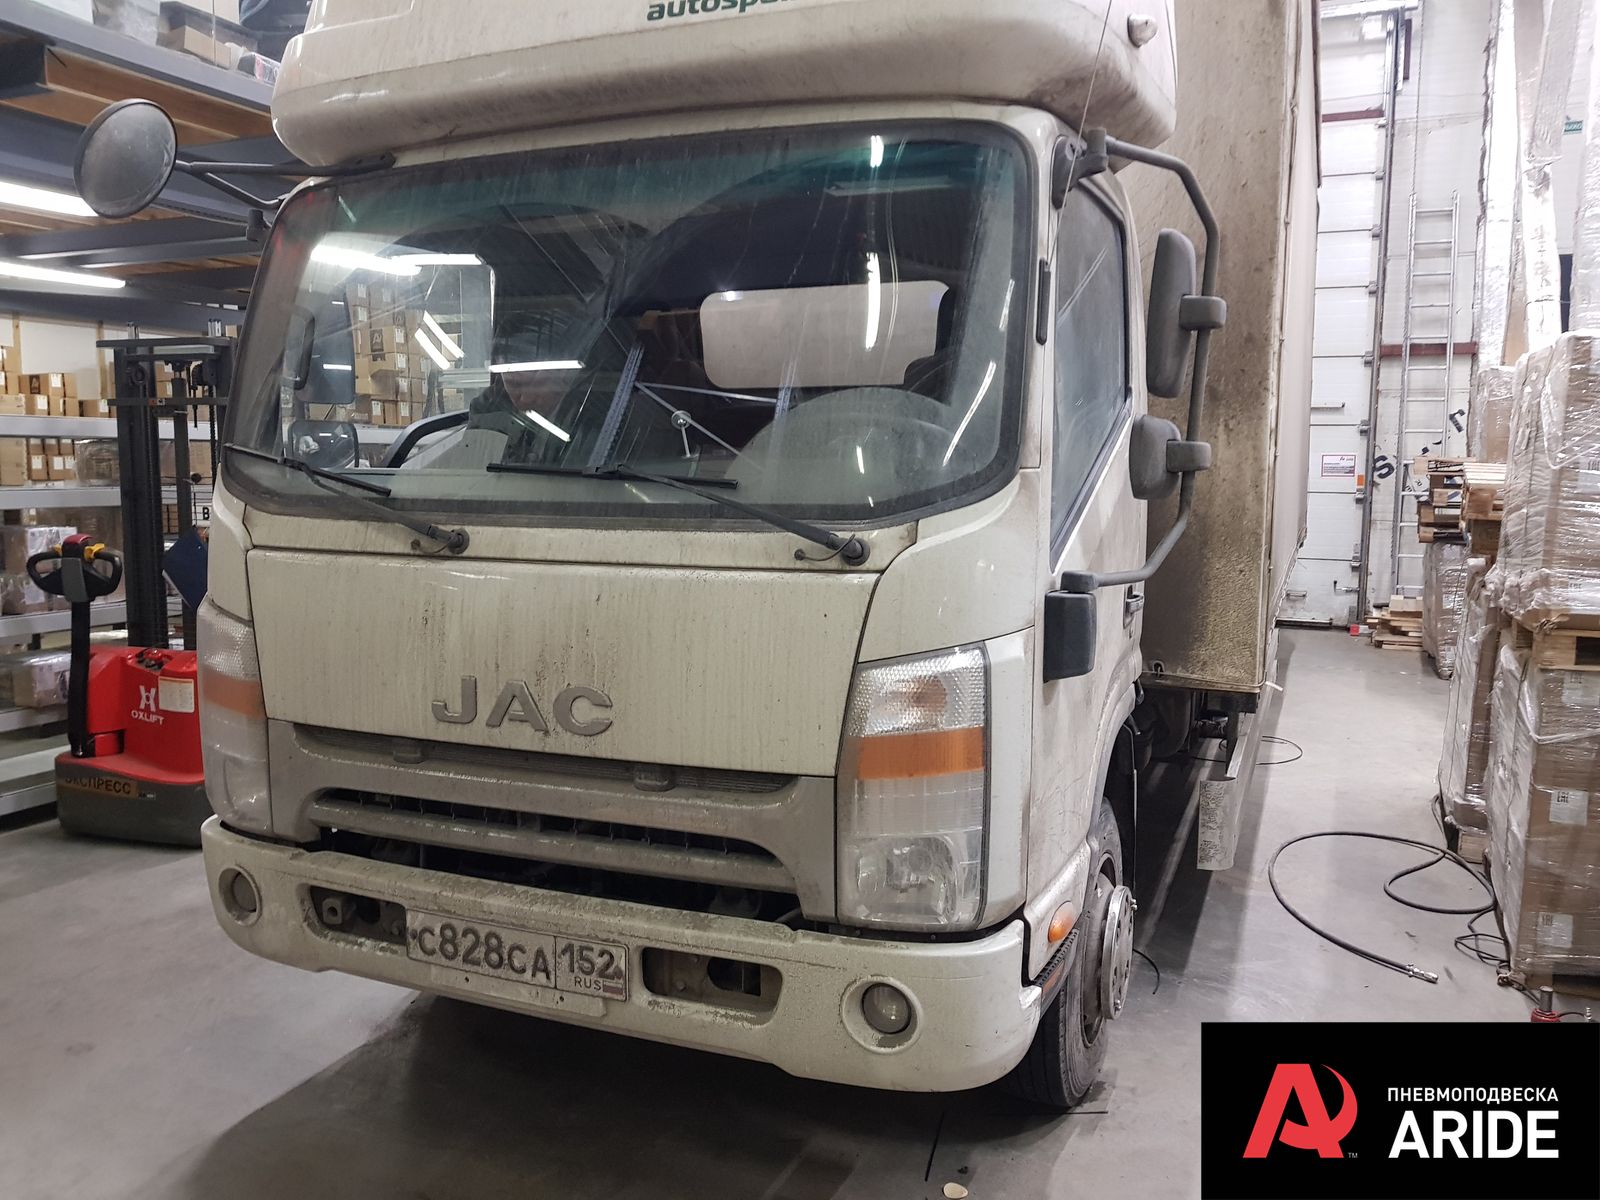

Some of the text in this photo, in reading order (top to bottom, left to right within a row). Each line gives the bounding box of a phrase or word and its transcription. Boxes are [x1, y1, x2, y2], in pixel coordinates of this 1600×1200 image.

[131, 709, 164, 725] OXLIFT
[431, 675, 613, 736] JAC
[560, 942, 616, 979] 152
[574, 976, 602, 991] RUS
